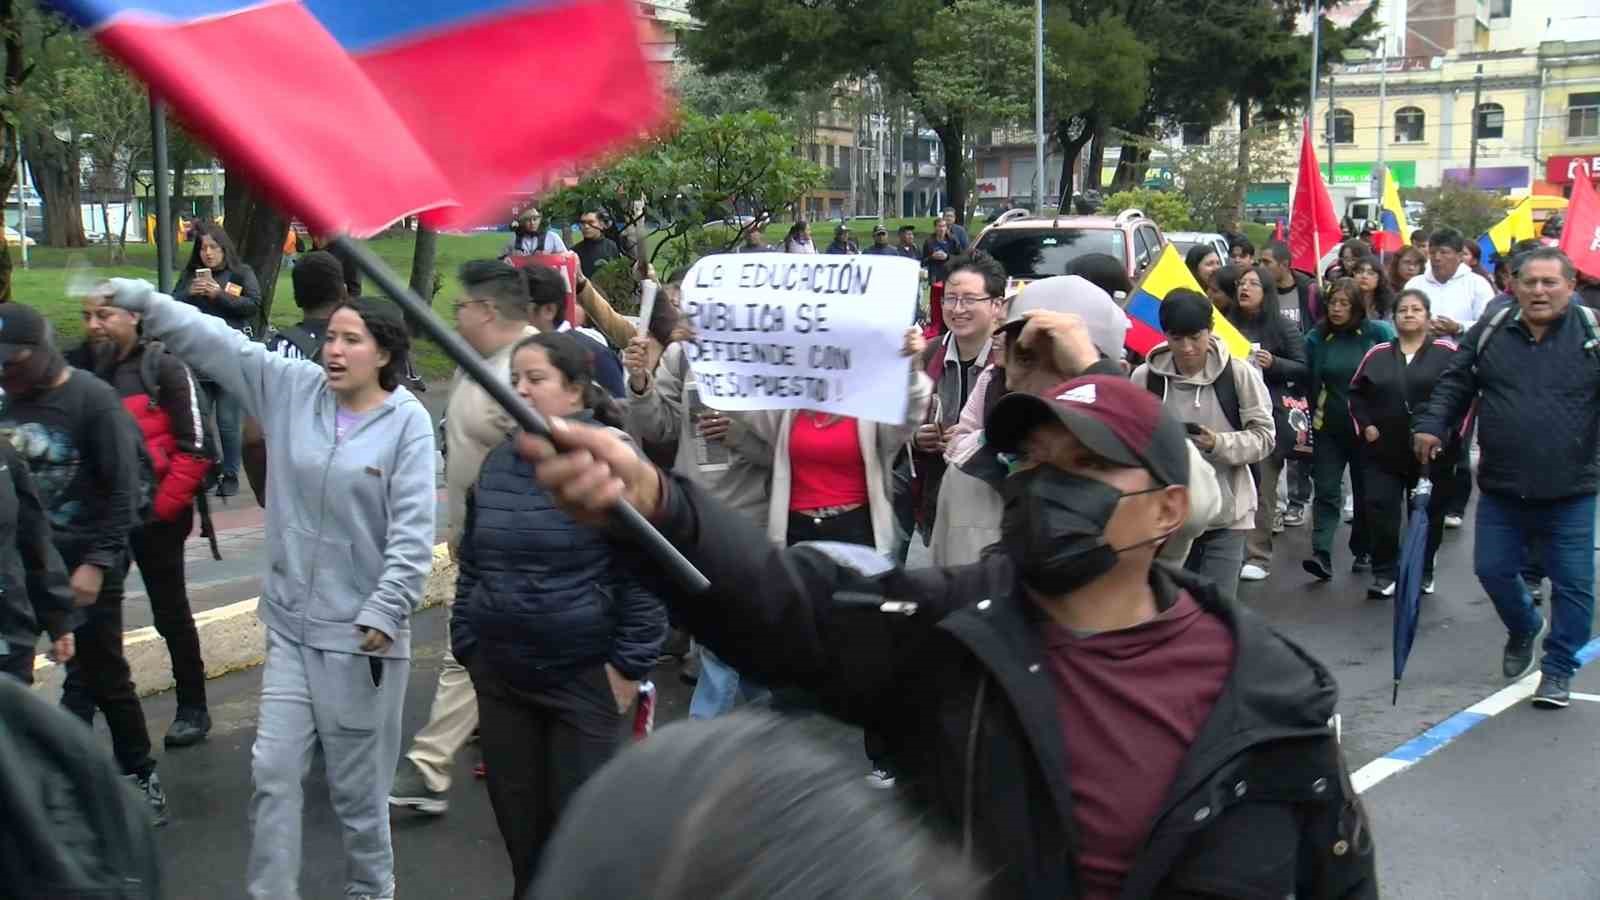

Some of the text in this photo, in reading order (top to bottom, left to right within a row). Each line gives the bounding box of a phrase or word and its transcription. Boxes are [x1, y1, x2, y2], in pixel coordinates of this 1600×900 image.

[695, 259, 872, 295] LA EDUCACIÓN
[794, 303, 831, 334] SE
[807, 344, 850, 370] CON
